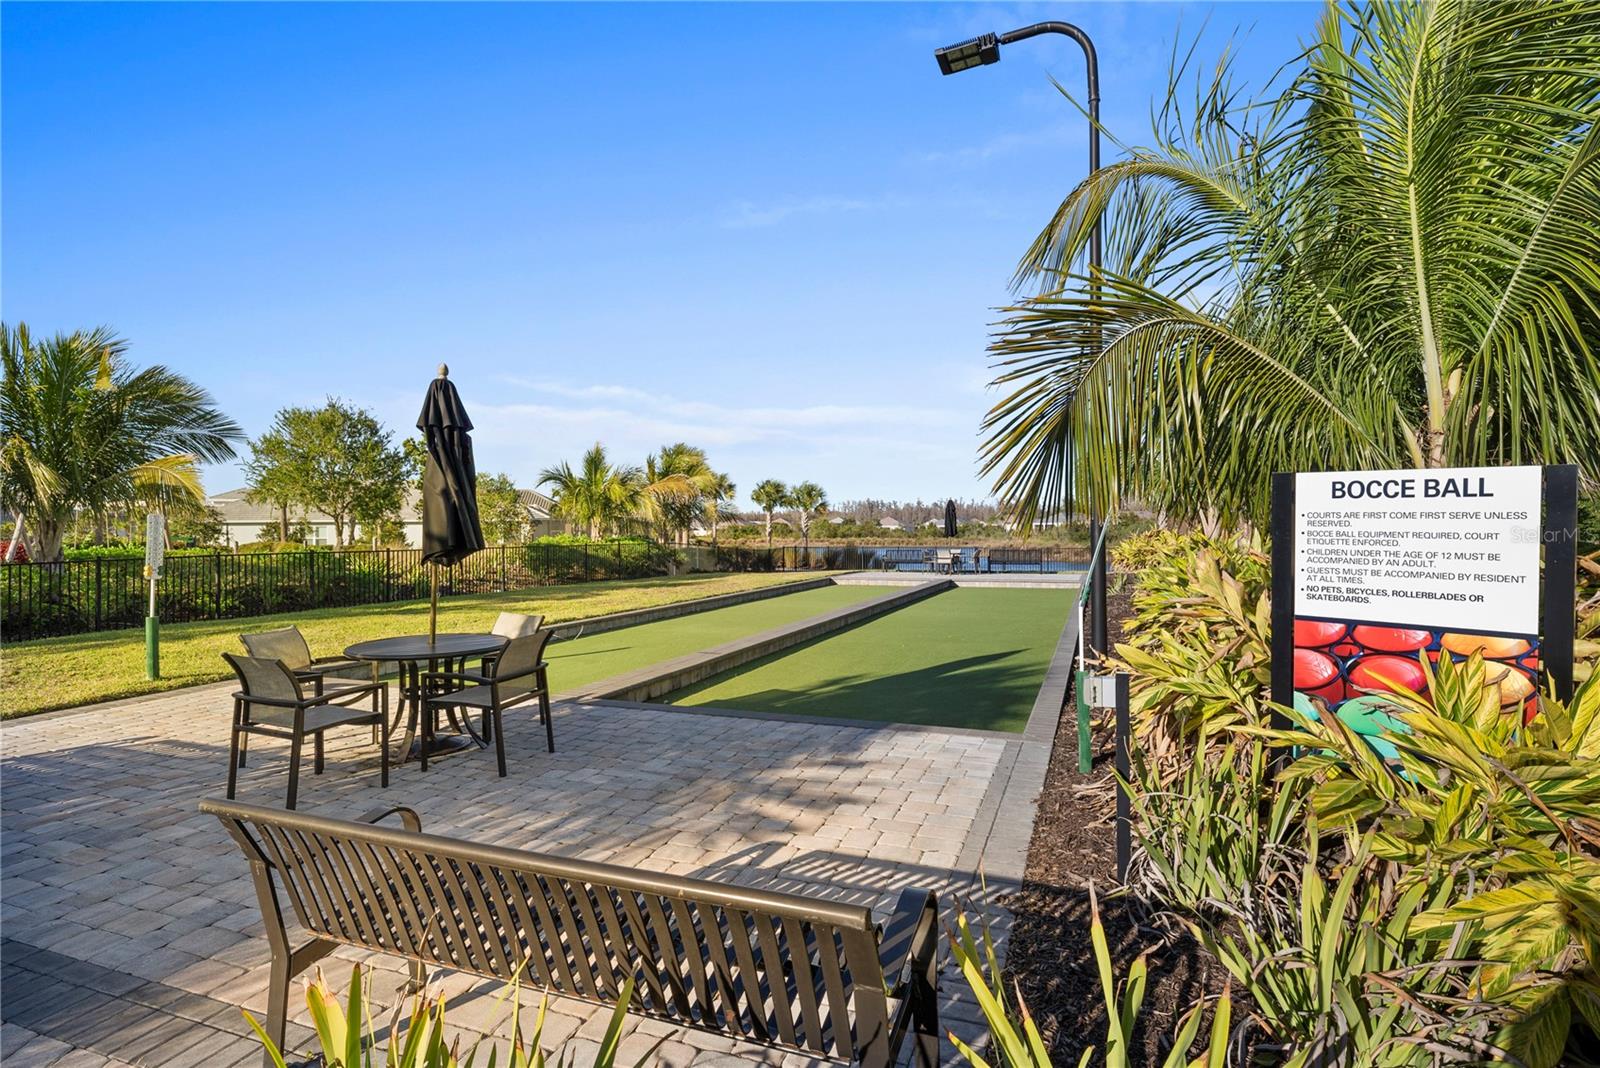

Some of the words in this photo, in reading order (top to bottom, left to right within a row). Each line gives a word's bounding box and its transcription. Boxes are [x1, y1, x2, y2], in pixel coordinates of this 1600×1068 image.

[1331, 479, 1415, 499] BOCCE
[1424, 477, 1494, 498] BALL
[1306, 511, 1342, 520] COURTS
[1343, 511, 1361, 520] ARE
[1362, 511, 1387, 520] FIRST
[1389, 511, 1417, 520] COME
[1419, 511, 1447, 520] FIRST
[1448, 511, 1481, 520] SERVE
[1484, 511, 1528, 520] UNLESS
[1306, 519, 1352, 528] RESERVED.
[1306, 530, 1334, 538] BOCCE
[1335, 530, 1356, 538] BALL
[1357, 530, 1410, 539] EQUIPMENT
[1411, 531, 1463, 541] REQUIRED,
[1464, 532, 1500, 541] COURT
[1306, 538, 1350, 546] ETIQUETTE
[1352, 538, 1401, 547] ENFORCED.
[1306, 548, 1348, 557] CHILDREN
[1349, 549, 1382, 558] UNDER
[1383, 550, 1401, 559] THE
[1403, 551, 1423, 560] AGE
[1425, 551, 1439, 560] OF
[1442, 552, 1452, 560] 12
[1454, 552, 1485, 561] MUST
[1487, 553, 1501, 561] BE
[1306, 556, 1370, 566] ACCOMPANIED
[1371, 558, 1385, 566] BY
[1386, 558, 1400, 567] AN
[1402, 559, 1437, 568] ADULT.
[1306, 566, 1341, 575] GUESTS
[1342, 568, 1369, 577] MUST
[1370, 569, 1382, 577] BE
[1384, 570, 1456, 581] ACCOMPANIED
[1457, 573, 1472, 581] BY
[1473, 573, 1527, 584] RESIDENT
[1306, 574, 1318, 582] AT
[1319, 575, 1335, 583] ALL
[1336, 576, 1365, 584] TIMES.
[1306, 585, 1319, 593] NO
[1320, 586, 1345, 595] PETS,
[1346, 587, 1390, 597] BICYCLES,
[1391, 589, 1467, 602] ROLLERBLADES
[1468, 593, 1485, 603] OR
[1306, 592, 1372, 604] SKATEBOARDS.
